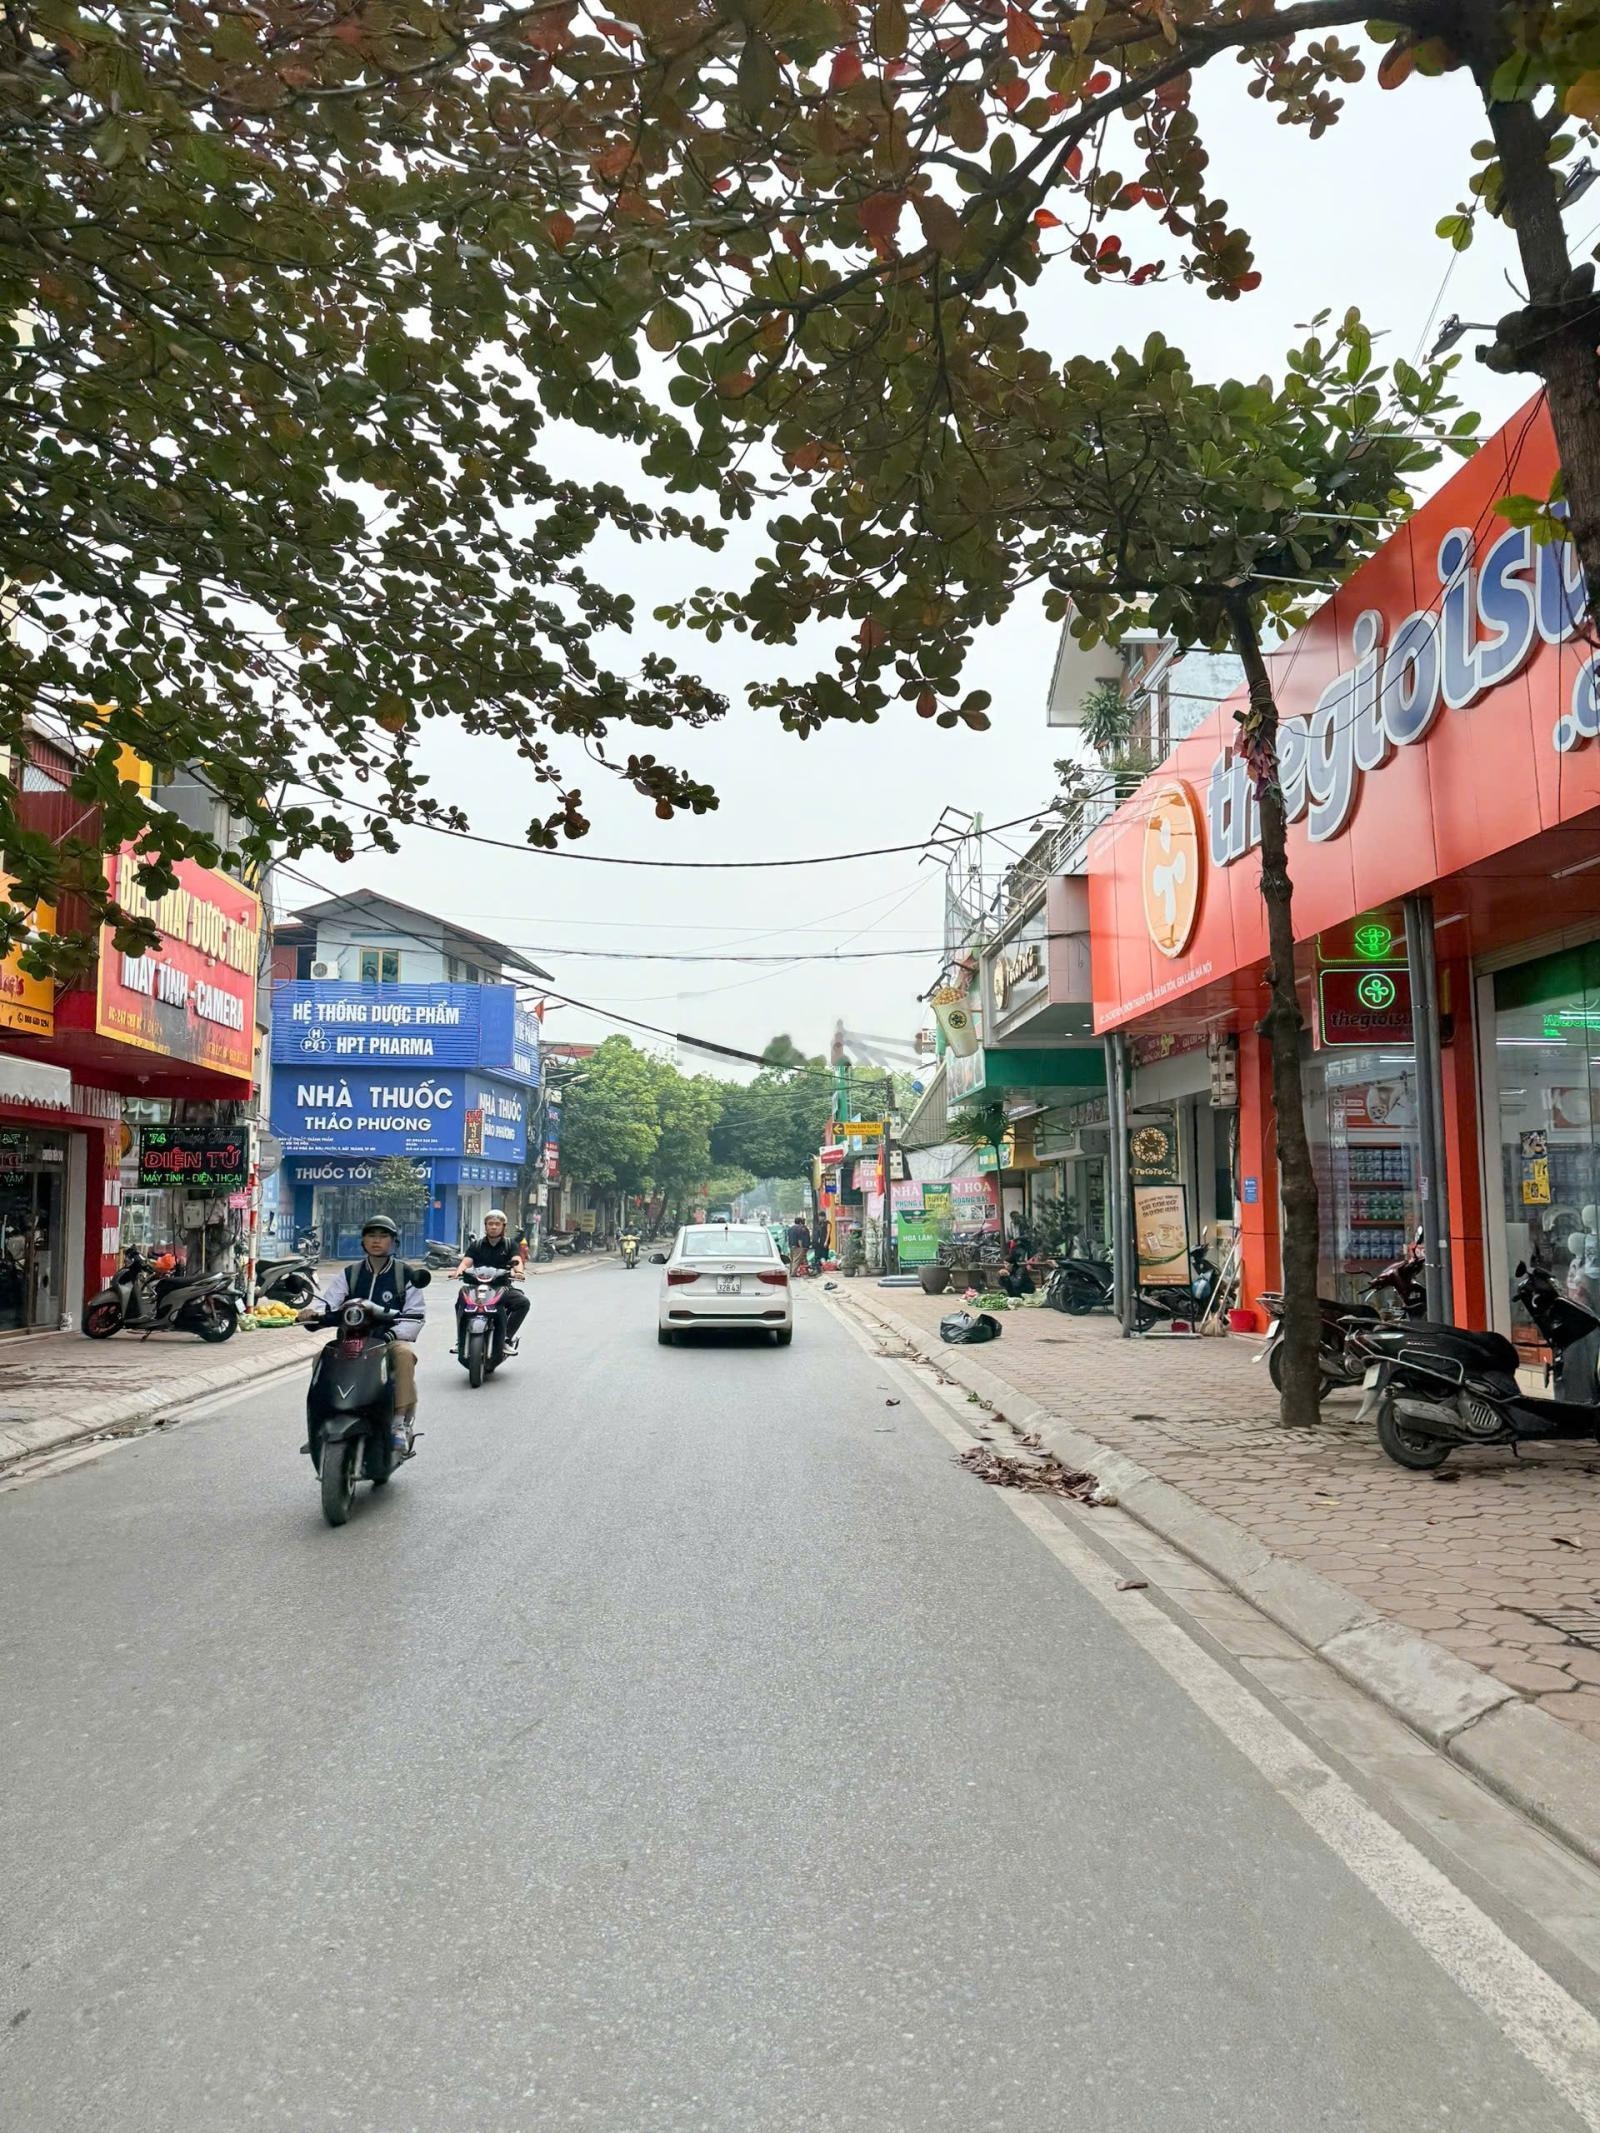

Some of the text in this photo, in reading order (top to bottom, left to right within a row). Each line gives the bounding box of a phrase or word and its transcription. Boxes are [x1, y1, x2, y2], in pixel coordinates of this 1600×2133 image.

[157, 957, 189, 1007] TÍNH
[195, 980, 244, 1032] CAMERA
[293, 1000, 312, 1025] HỆ
[317, 999, 367, 1022] THỐNG
[416, 1001, 460, 1024] PHẨM
[336, 1037, 434, 1056] HPT PHARMA
[296, 1079, 454, 1110] NHÀ THUỐC
[479, 1088, 522, 1122] NHÀ THUỐC
[304, 1111, 432, 1131] THẢO PHƯƠNG
[144, 1146, 202, 1173] ĐIỆN
[295, 1161, 344, 1180] THUỐC
[143, 1170, 163, 1183] MÁY
